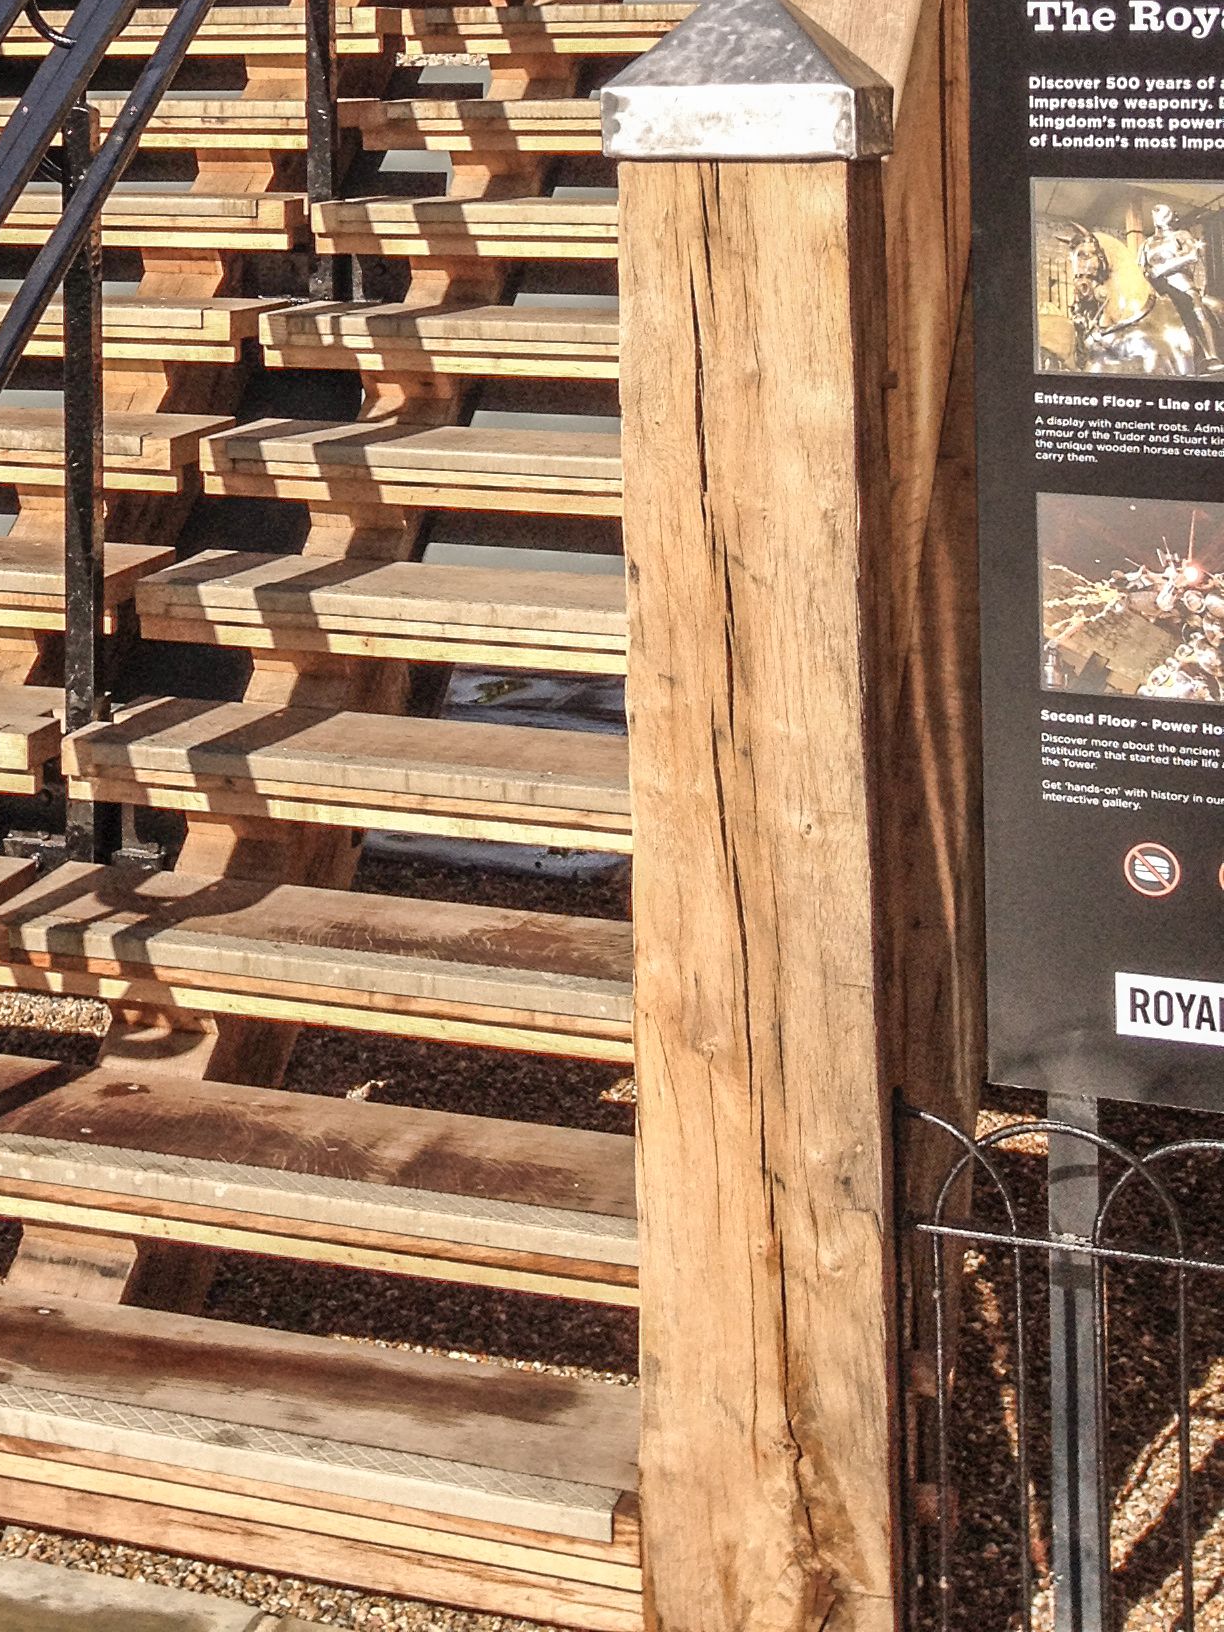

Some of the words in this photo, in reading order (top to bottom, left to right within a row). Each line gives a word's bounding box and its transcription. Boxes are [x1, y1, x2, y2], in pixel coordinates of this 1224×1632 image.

[1027, 0, 1116, 32] The
[1128, 0, 1224, 39] Roy
[1029, 75, 1101, 90] Discover
[1106, 76, 1140, 90] 500
[1145, 77, 1192, 92] years
[1197, 76, 1215, 90] of
[1029, 95, 1119, 111] impressive
[1124, 96, 1214, 112] weaponry.
[1029, 114, 1116, 130] kingdom's
[1121, 115, 1163, 129] most
[1029, 133, 1047, 148] of
[1052, 134, 1129, 148] London's
[1134, 135, 1177, 149] most
[1034, 391, 1098, 407] Entrance
[1102, 395, 1142, 409] Floor
[1158, 397, 1190, 411] Line
[1194, 399, 1210, 412] of
[1034, 415, 1043, 425] A
[1046, 415, 1085, 428] display
[1088, 418, 1111, 429] with
[1114, 420, 1155, 431] ancient
[1158, 422, 1190, 433] roots.
[1035, 428, 1074, 438] armour
[1077, 429, 1089, 439] of
[1092, 430, 1110, 440] the
[1113, 431, 1146, 442] Tudor
[1148, 433, 1170, 444] and
[1172, 434, 1208, 445] Stuart
[1035, 439, 1053, 450] the
[1056, 441, 1093, 452] unique
[1096, 442, 1140, 454] wooden
[1143, 444, 1180, 456] horses
[1035, 452, 1065, 463] carry
[1067, 452, 1098, 464] them.
[1040, 709, 1094, 725] Second
[1098, 714, 1138, 729] Floor
[1152, 718, 1198, 734] Power
[1041, 732, 1088, 746] Discover
[1091, 738, 1120, 749] more
[1122, 740, 1155, 752] about
[1158, 743, 1177, 754] the
[1179, 746, 1220, 757] ancient
[1041, 744, 1101, 759] institutions
[1104, 749, 1127, 761] that
[1129, 752, 1170, 765] started
[1172, 755, 1198, 767] their
[1201, 758, 1219, 769] life
[1041, 756, 1060, 767] the
[1062, 758, 1098, 770] Tower.
[1042, 779, 1062, 791] Get
[1124, 787, 1148, 799] with
[1151, 789, 1190, 804] history
[1192, 793, 1203, 803] in
[1042, 792, 1099, 806] interactive
[1102, 797, 1142, 811] gallery.
